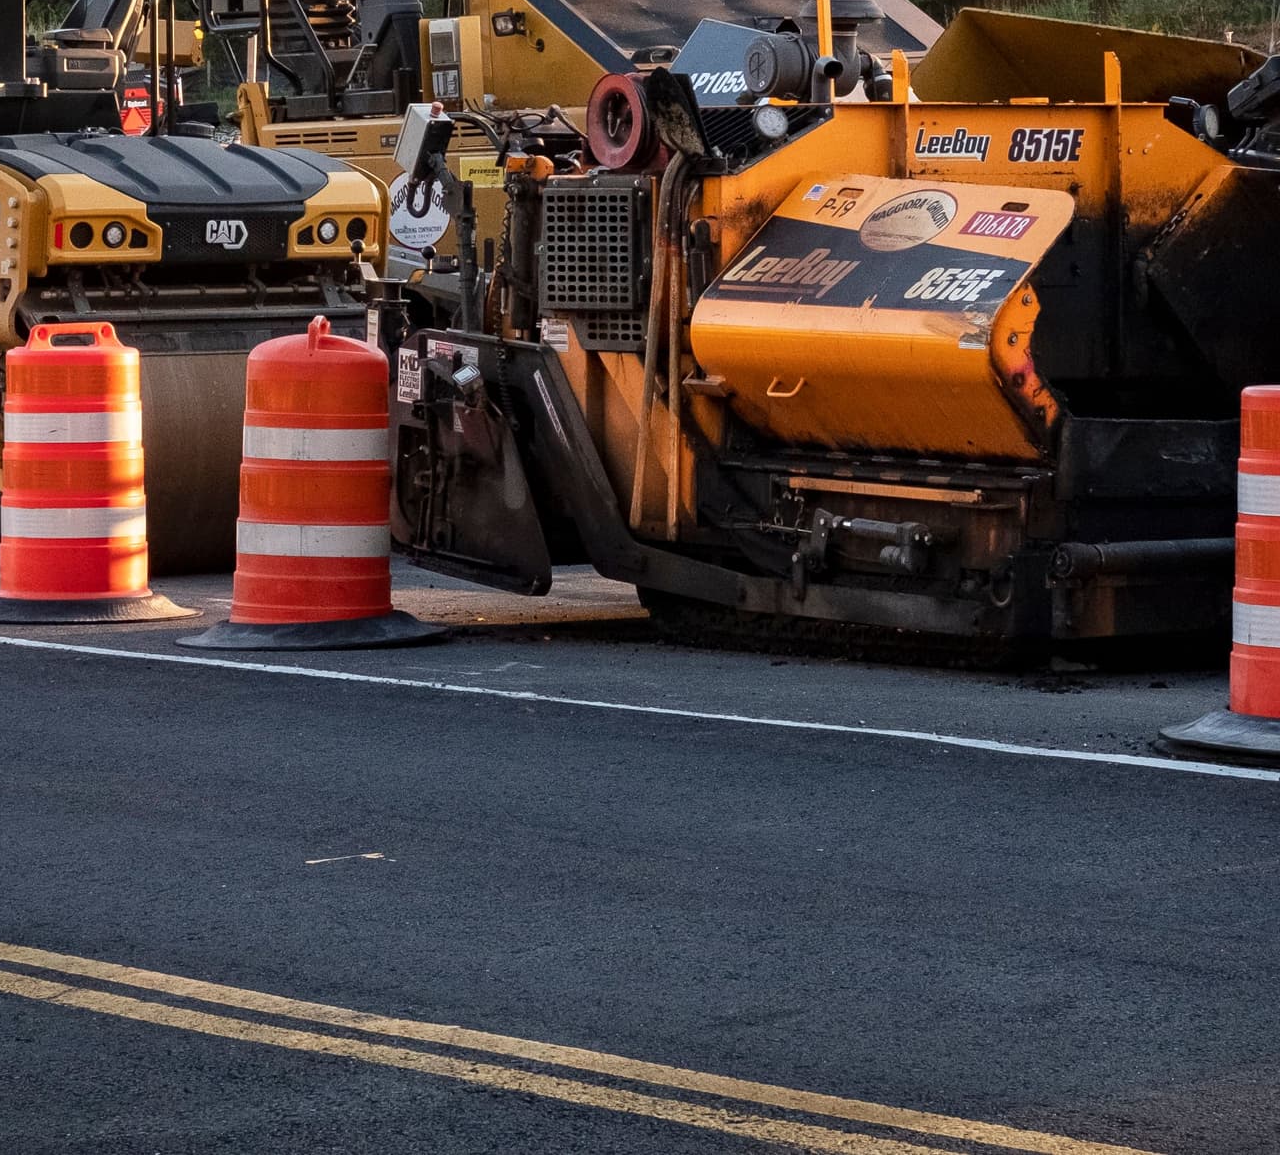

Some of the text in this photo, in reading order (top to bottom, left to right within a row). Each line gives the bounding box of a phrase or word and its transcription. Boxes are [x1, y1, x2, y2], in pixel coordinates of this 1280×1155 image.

[915, 128, 1084, 162] LeeBoy 8515E
[815, 198, 857, 218] P-19
[869, 198, 925, 223] MAGGIORA
[927, 200, 950, 230] GHILOTTI
[206, 220, 242, 244] CAT
[967, 213, 1030, 236] VD6A78
[722, 246, 1006, 302] LeeBoy 8515E
